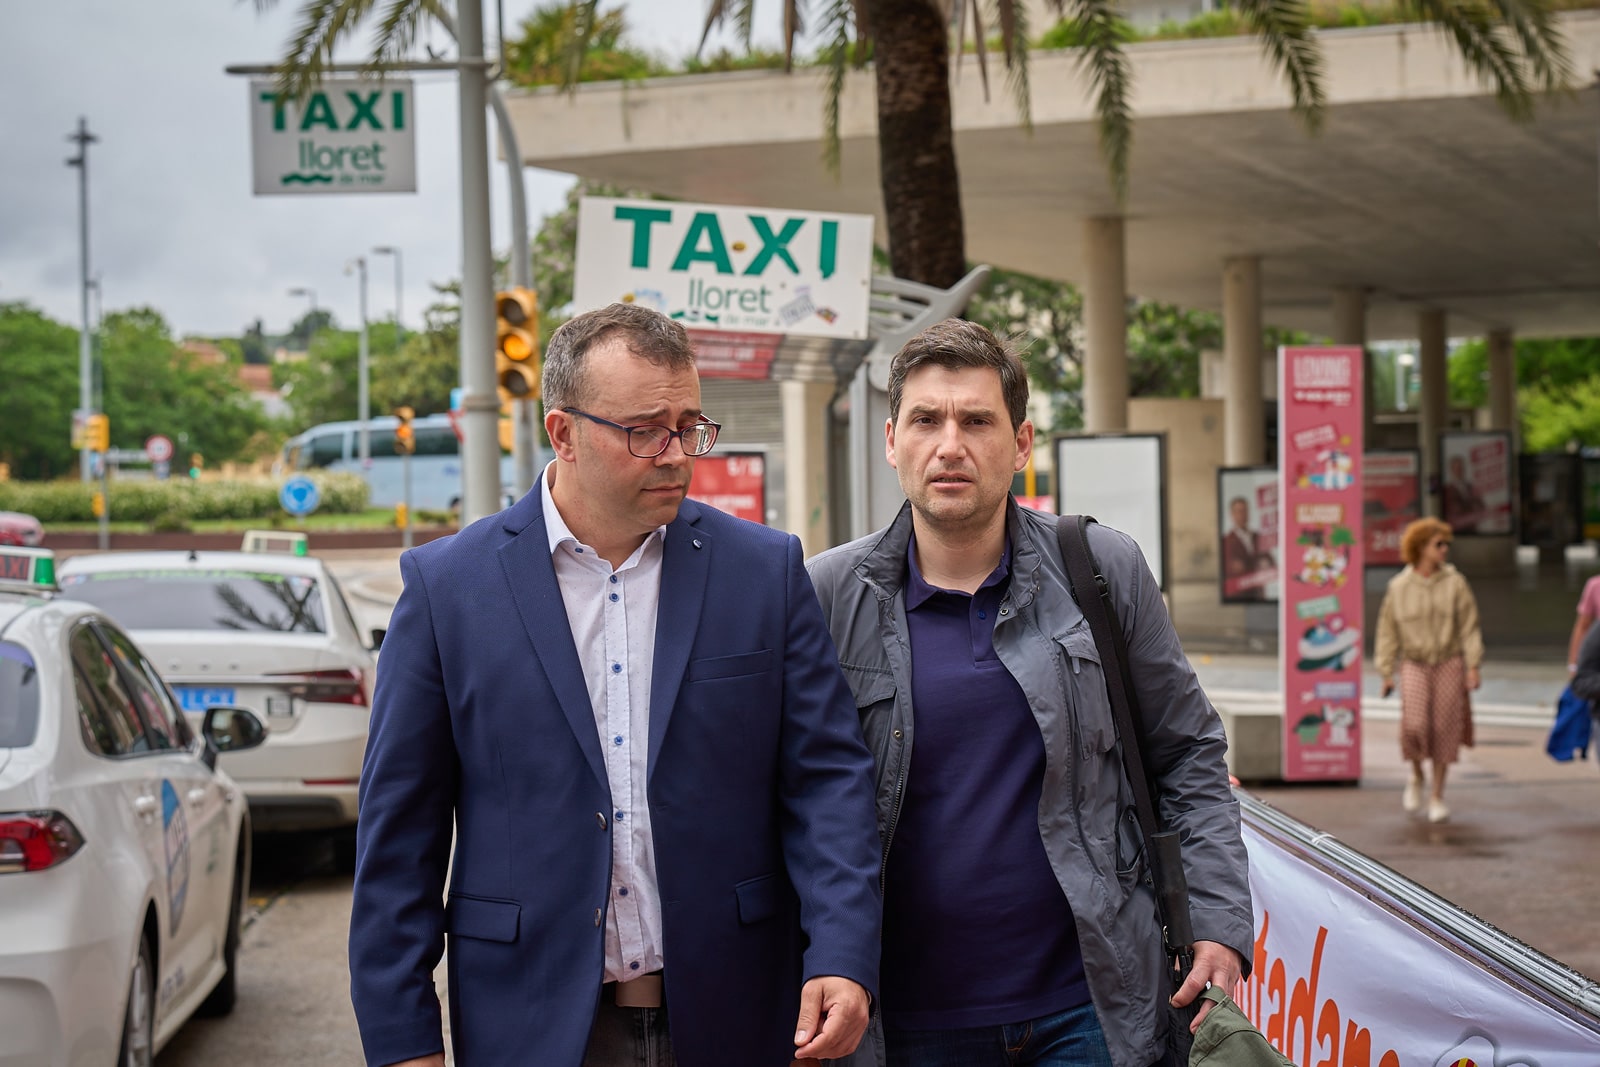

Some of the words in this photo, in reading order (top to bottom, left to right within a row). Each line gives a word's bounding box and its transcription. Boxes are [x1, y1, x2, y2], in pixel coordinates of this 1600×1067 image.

[260, 91, 404, 131] TAXI
[299, 139, 385, 171] lloret
[614, 205, 839, 280] TAXI
[688, 278, 772, 314] lloret
